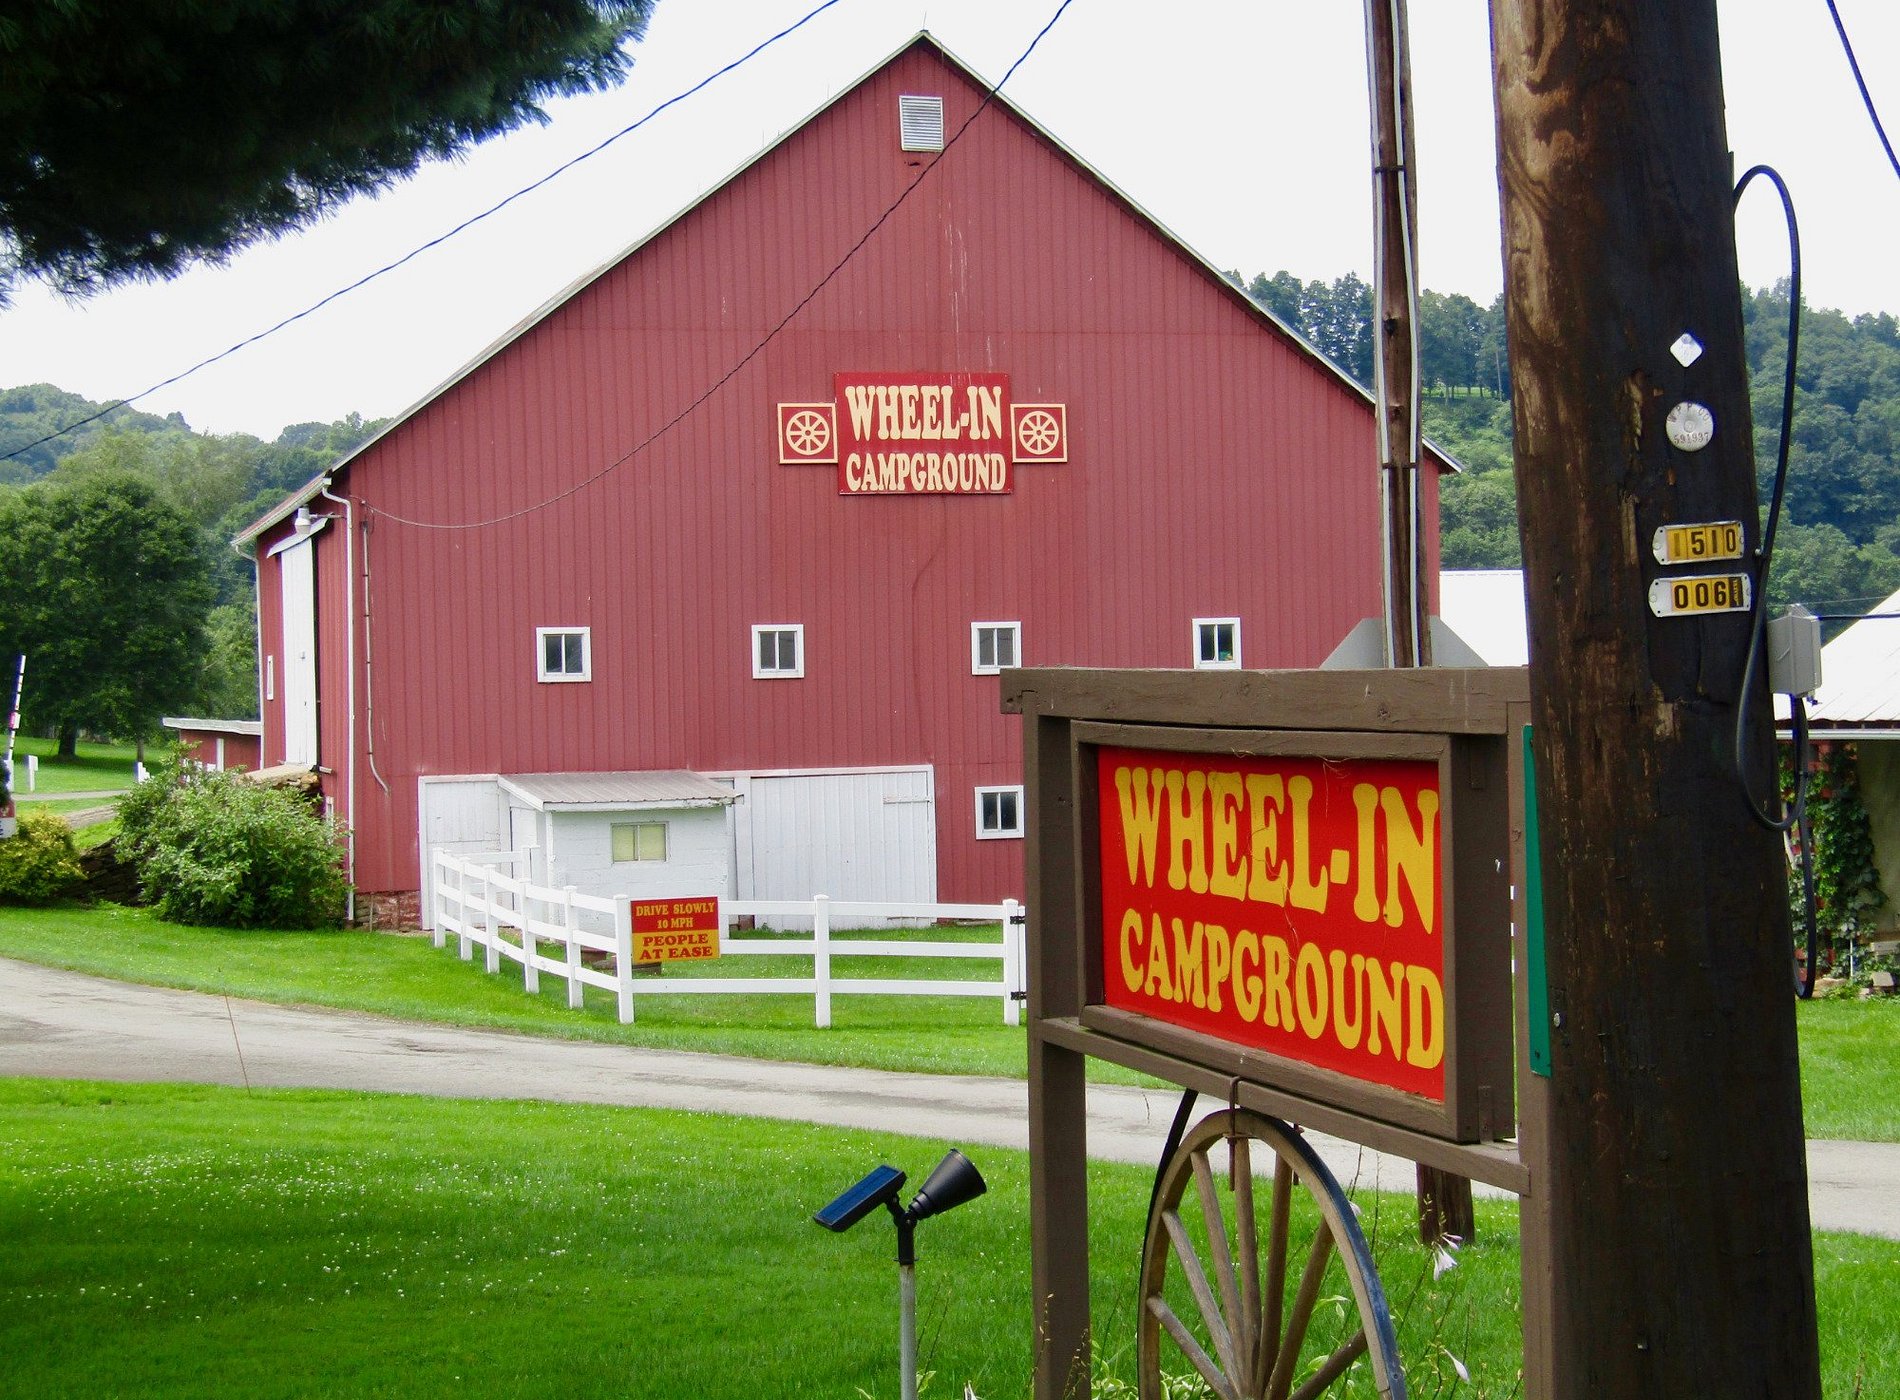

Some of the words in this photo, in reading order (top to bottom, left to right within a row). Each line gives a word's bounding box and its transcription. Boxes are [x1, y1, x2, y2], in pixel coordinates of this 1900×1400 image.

[845, 384, 1002, 441] WHEEL-IN
[846, 453, 1006, 491] CAMPGROUND
[1673, 528, 1736, 556] 1510
[1114, 766, 1439, 934] WHEEL-IN
[636, 905, 669, 916] DRIVE
[673, 902, 715, 914] SLOWLY
[657, 919, 669, 929] 10
[671, 917, 694, 928] MPH
[640, 949, 663, 960] AT
[668, 946, 713, 958] EASE
[643, 933, 709, 947] PEOPLE
[1120, 908, 1444, 1069] CAMPGROUND
